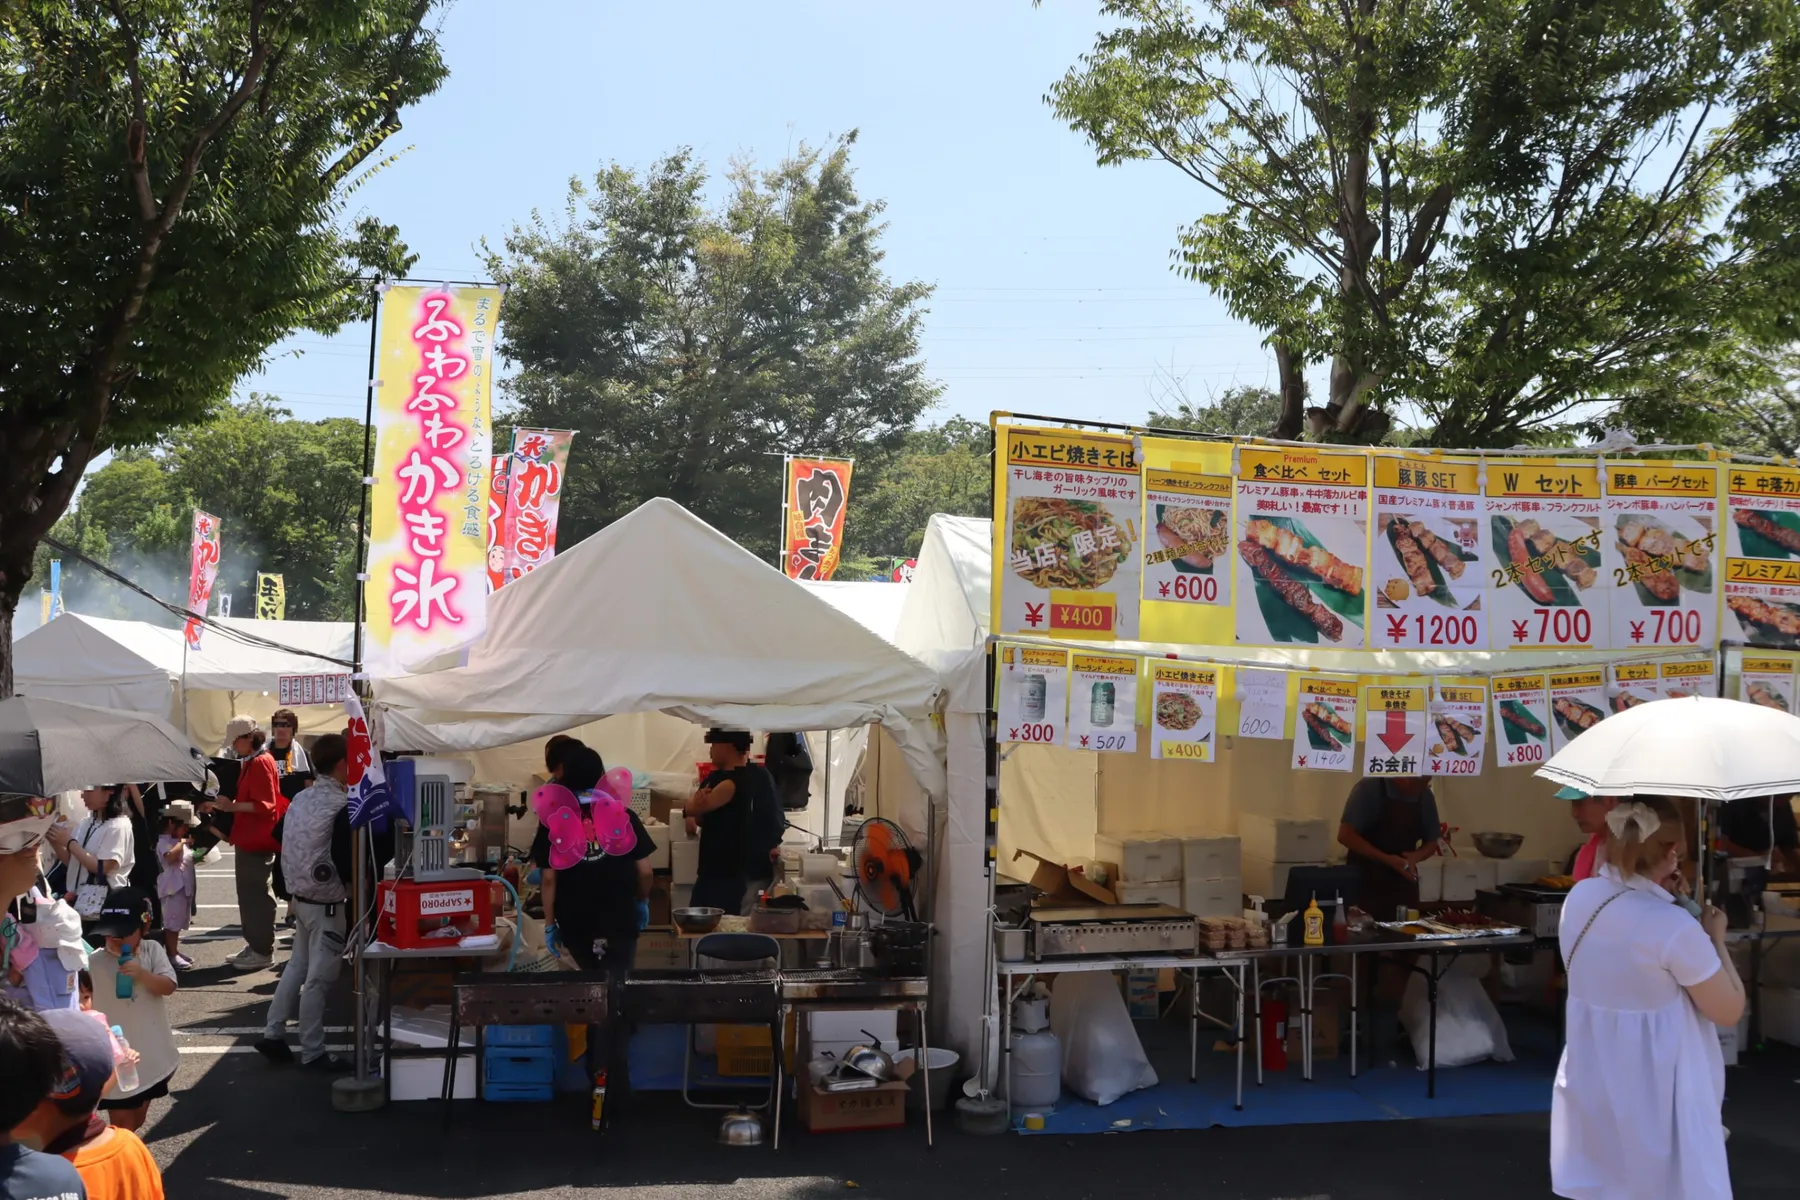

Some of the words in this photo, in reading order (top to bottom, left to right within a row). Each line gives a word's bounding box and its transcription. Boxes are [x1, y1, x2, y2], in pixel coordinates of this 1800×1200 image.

[462, 296, 490, 537] まるで雪のような、とろける食感
[519, 435, 546, 457] 氷
[1012, 441, 1137, 468] 小エビ焼きそば
[391, 299, 467, 629] ふわふわかき氷
[1283, 454, 1318, 464] Premium
[1014, 469, 1127, 487] 干し海老の旨味タップリの
[1254, 463, 1308, 479] 食べ比べ
[1318, 467, 1351, 481] セット
[1614, 473, 1638, 488] 豚串
[1645, 474, 1709, 489] バーグセット
[1503, 472, 1519, 491] W
[1535, 473, 1582, 493] セット
[1732, 474, 1746, 490] 牛
[1053, 484, 1137, 500] ガーリック風味です
[1491, 529, 1603, 588] 2本セットです
[1613, 532, 1717, 588] 2本セットです
[1158, 575, 1218, 602] ¥600
[1061, 606, 1103, 626] ¥400
[1386, 612, 1478, 646] ¥1200
[1511, 608, 1592, 643] ¥700
[1629, 609, 1700, 643] ¥700
[1155, 669, 1215, 684] 小エビ焼きそば
[1627, 667, 1650, 678] セット
[1665, 664, 1709, 674] フランクフルト
[1381, 689, 1411, 699] 焼きそば
[1385, 700, 1407, 710] 串焼き
[1009, 723, 1054, 743] ¥300
[1096, 735, 1126, 750] 500
[1166, 743, 1202, 757] ¥400
[1314, 753, 1346, 765] 1400
[1507, 744, 1543, 763] ¥800
[1369, 755, 1417, 773] お会計
[1431, 759, 1476, 774] ¥1200
[421, 897, 462, 909] SAPPORO
